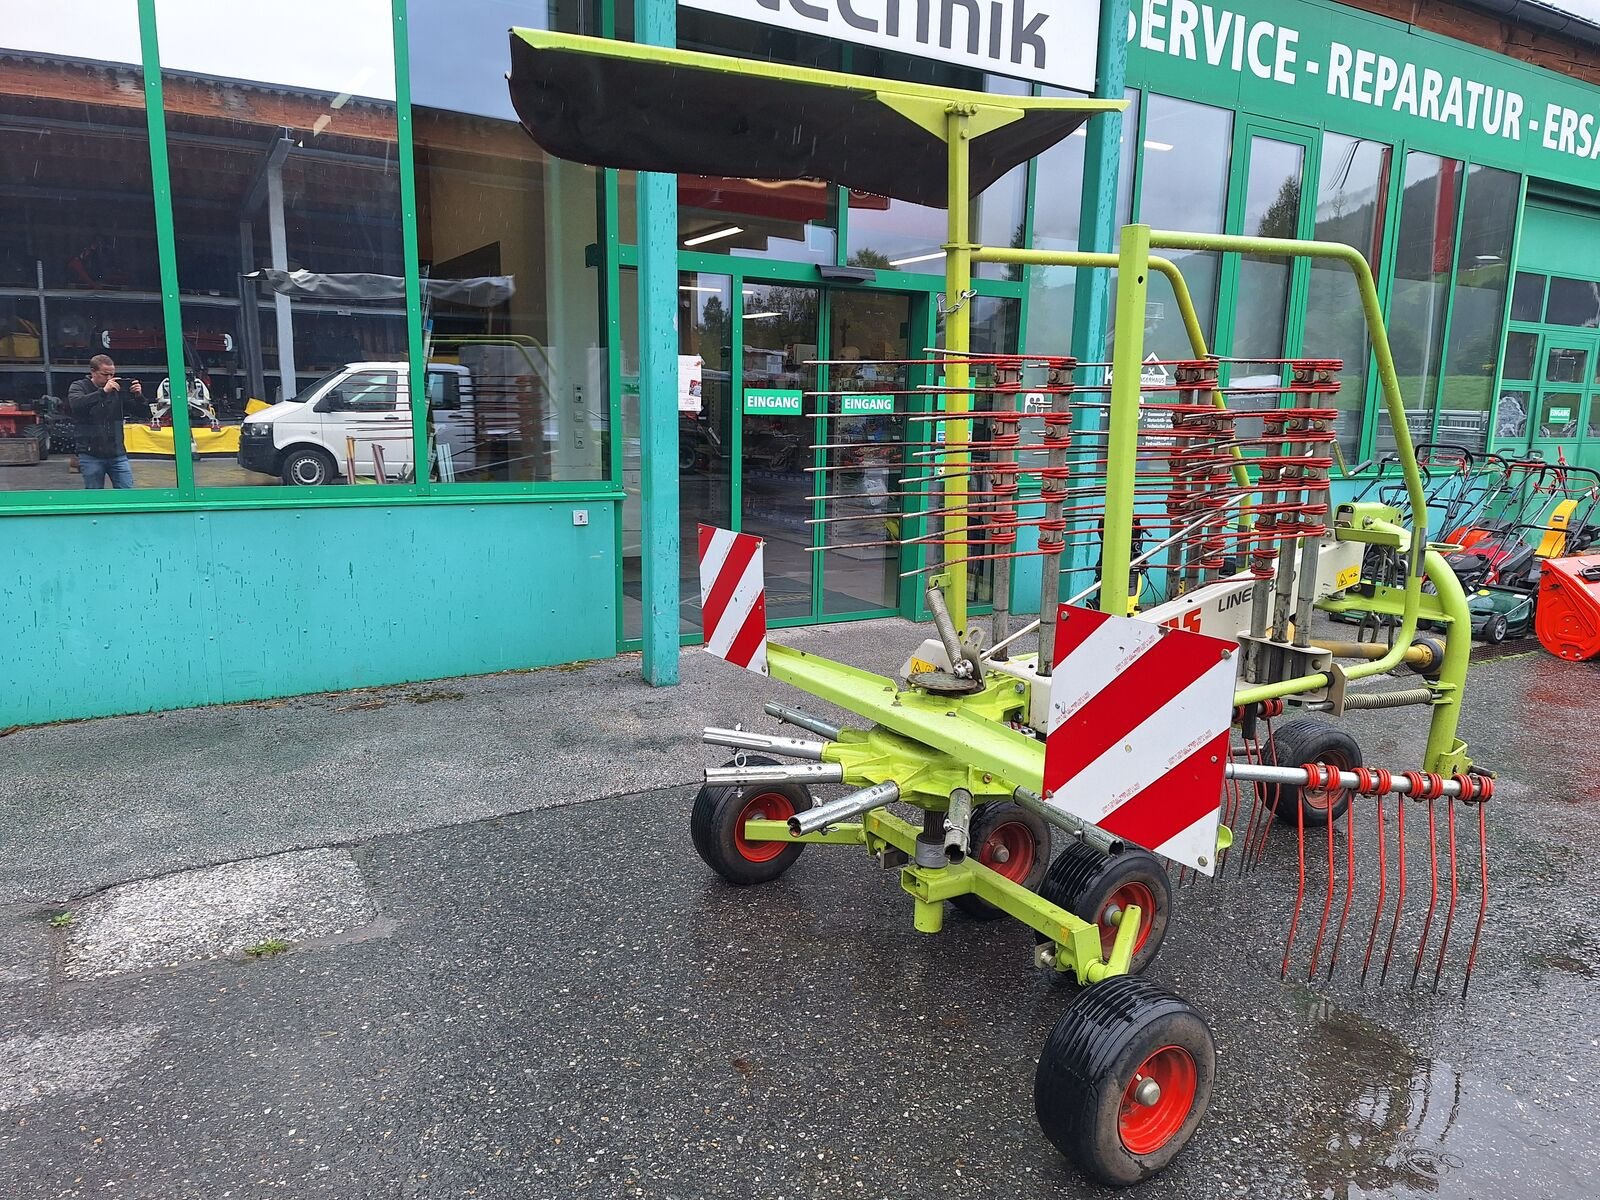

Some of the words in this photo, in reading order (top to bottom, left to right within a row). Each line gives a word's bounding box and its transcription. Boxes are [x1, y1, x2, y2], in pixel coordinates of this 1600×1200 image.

[755, 0, 1050, 70] chnik
[1326, 42, 1525, 141] REPARATUR
[747, 396, 799, 409] EINGANG
[844, 398, 892, 410] EINGANG
[1218, 587, 1253, 613] LINE
